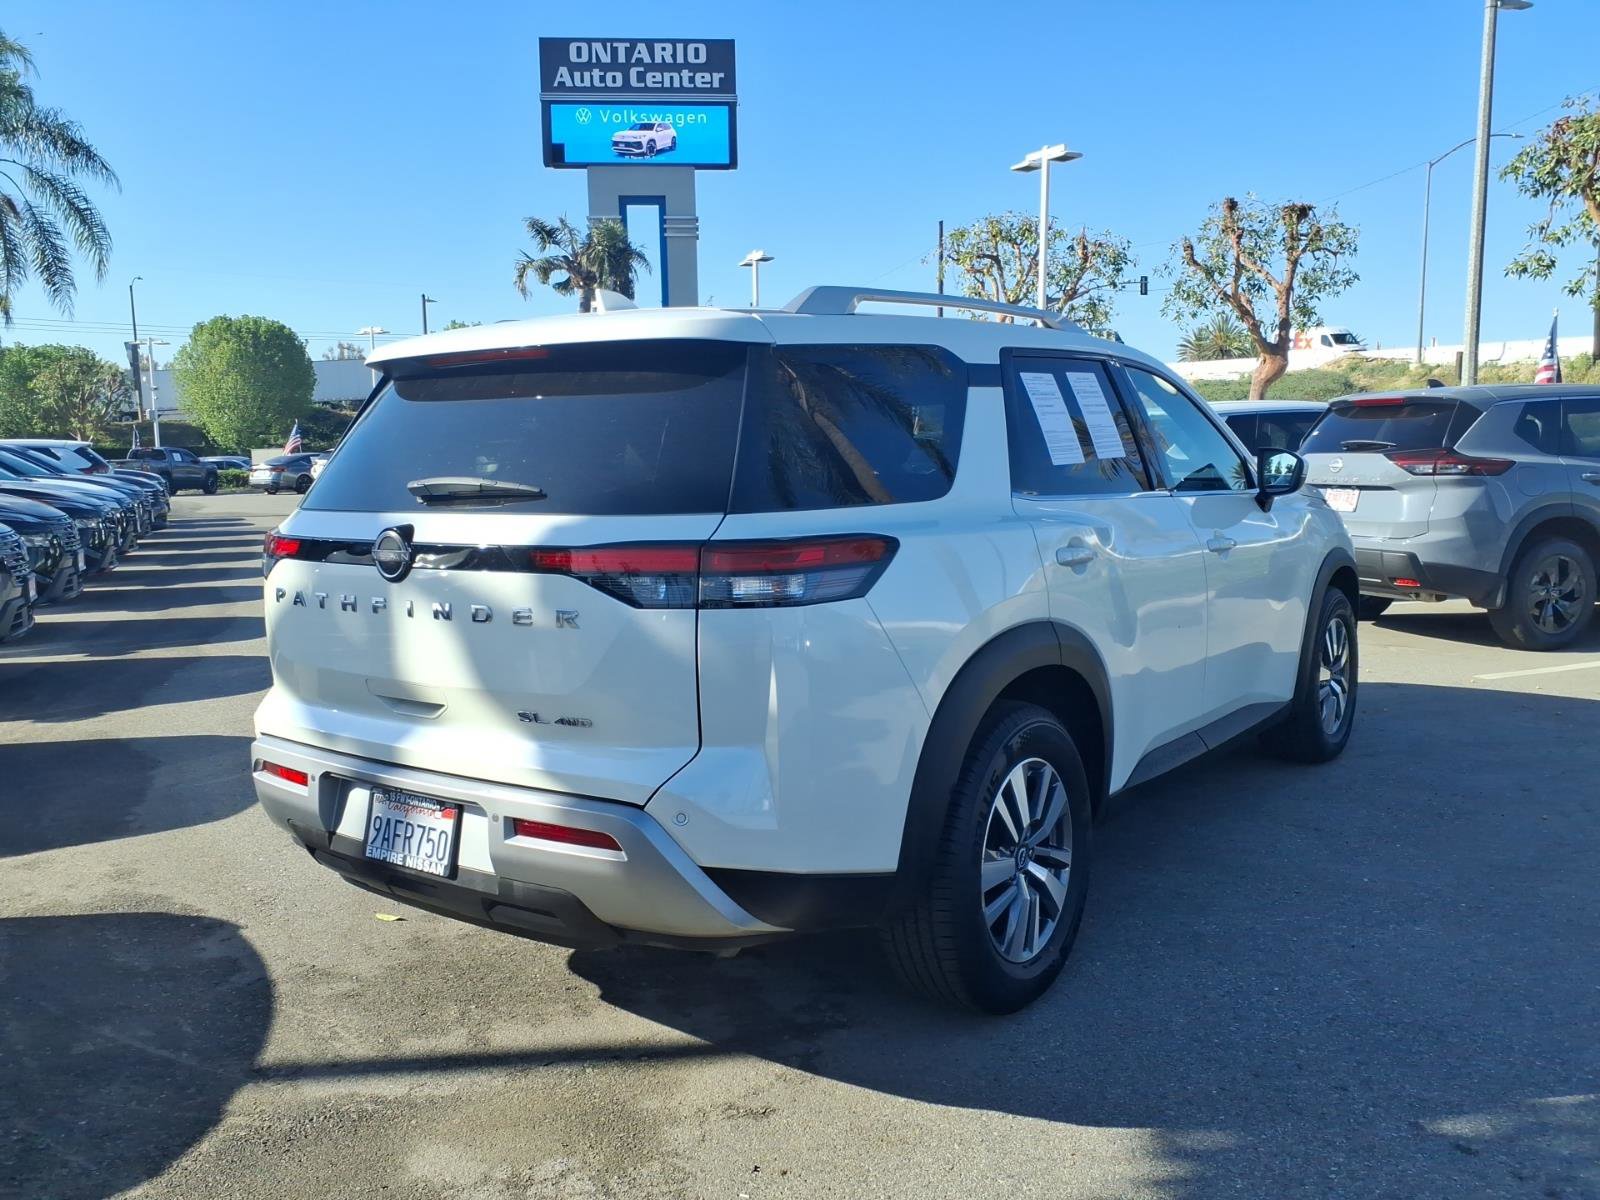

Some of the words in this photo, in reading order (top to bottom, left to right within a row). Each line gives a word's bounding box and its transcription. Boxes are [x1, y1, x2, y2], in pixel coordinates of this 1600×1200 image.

[569, 42, 707, 64] ONTARIO
[553, 66, 623, 88] Auto
[629, 66, 725, 88] Center
[600, 110, 707, 127] Volkswagen
[275, 587, 580, 629] PATHFINDER
[517, 710, 550, 724] SL
[370, 816, 448, 860] 9AFR750
[365, 845, 404, 865] EMPIRE
[405, 854, 446, 876] NISSAN
